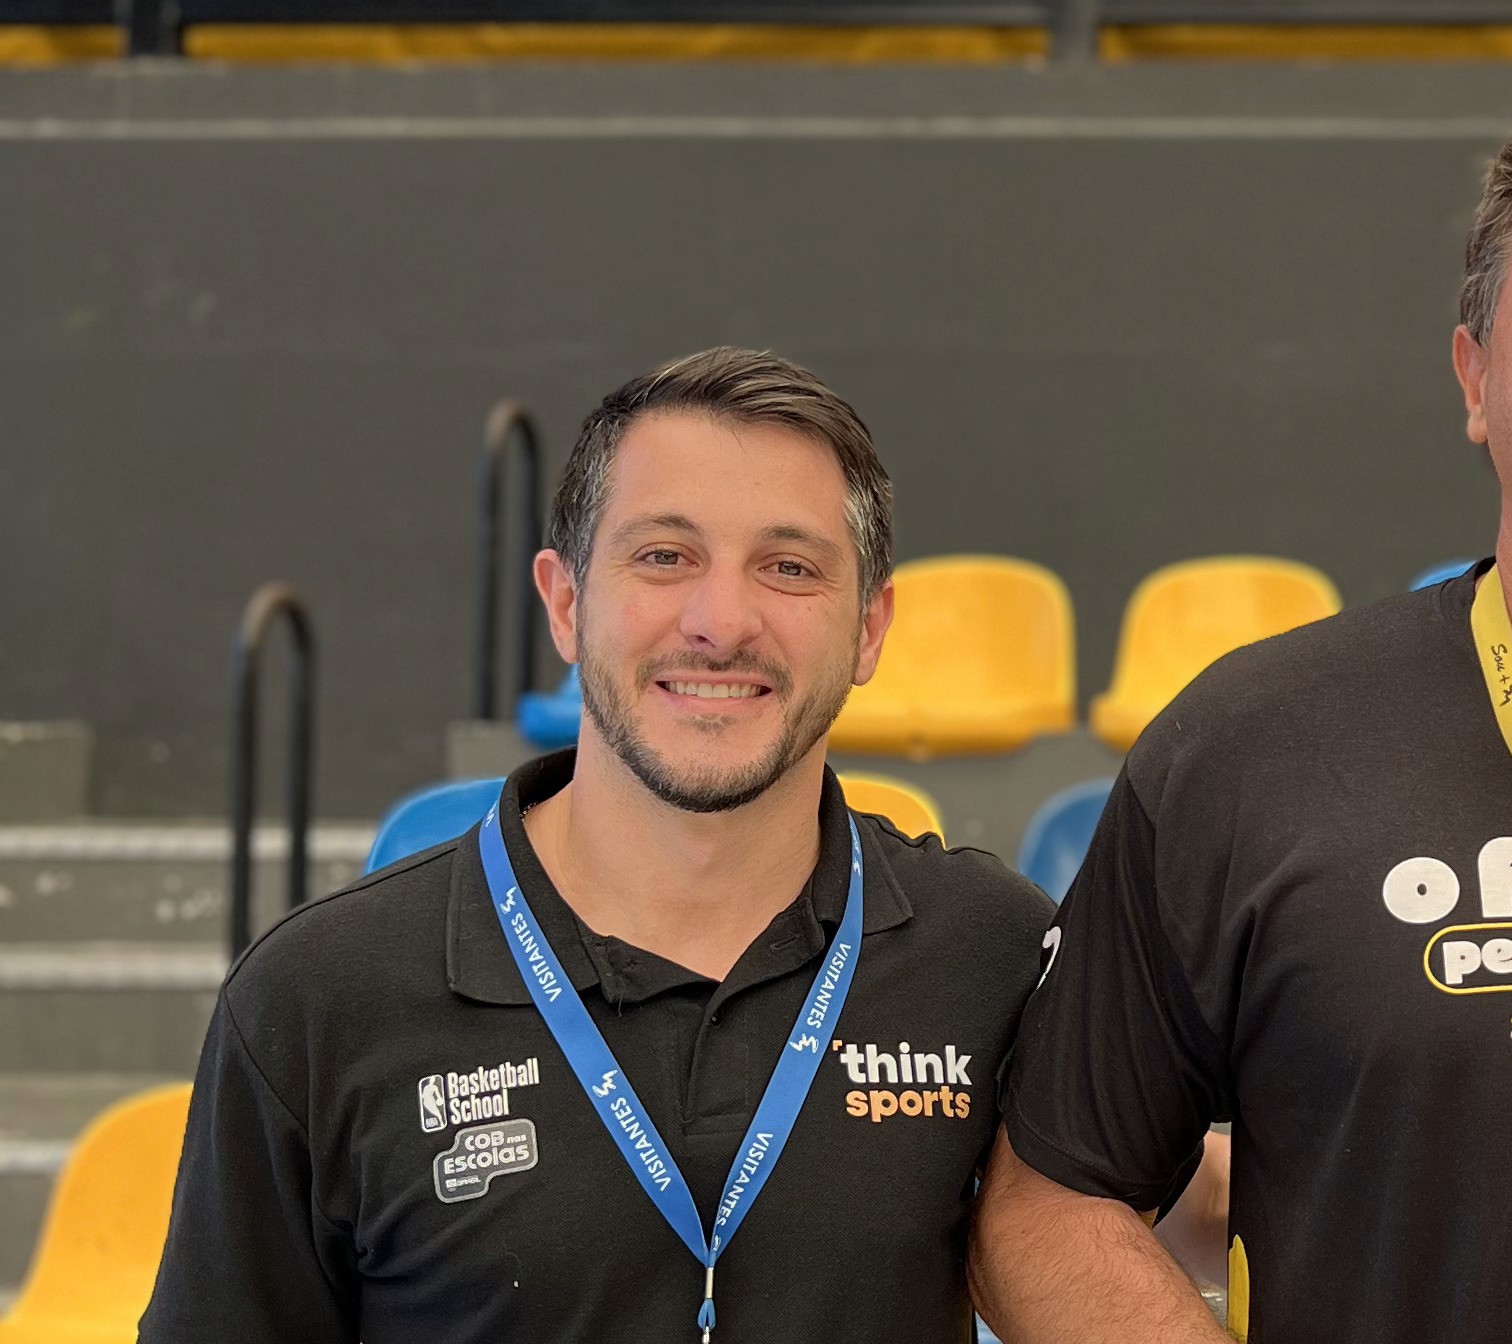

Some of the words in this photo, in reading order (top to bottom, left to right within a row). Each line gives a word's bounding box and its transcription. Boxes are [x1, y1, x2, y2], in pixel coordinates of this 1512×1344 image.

[511, 912, 563, 1002] VISITANTES
[806, 942, 851, 1029] VISITANTES
[447, 1057, 540, 1099] Basketball
[840, 1041, 972, 1085] think
[450, 1089, 510, 1125] School
[845, 1085, 971, 1122] sports
[464, 1130, 505, 1151] COB
[610, 1097, 672, 1192] VISITANTES
[716, 1132, 774, 1226] VISITANTES
